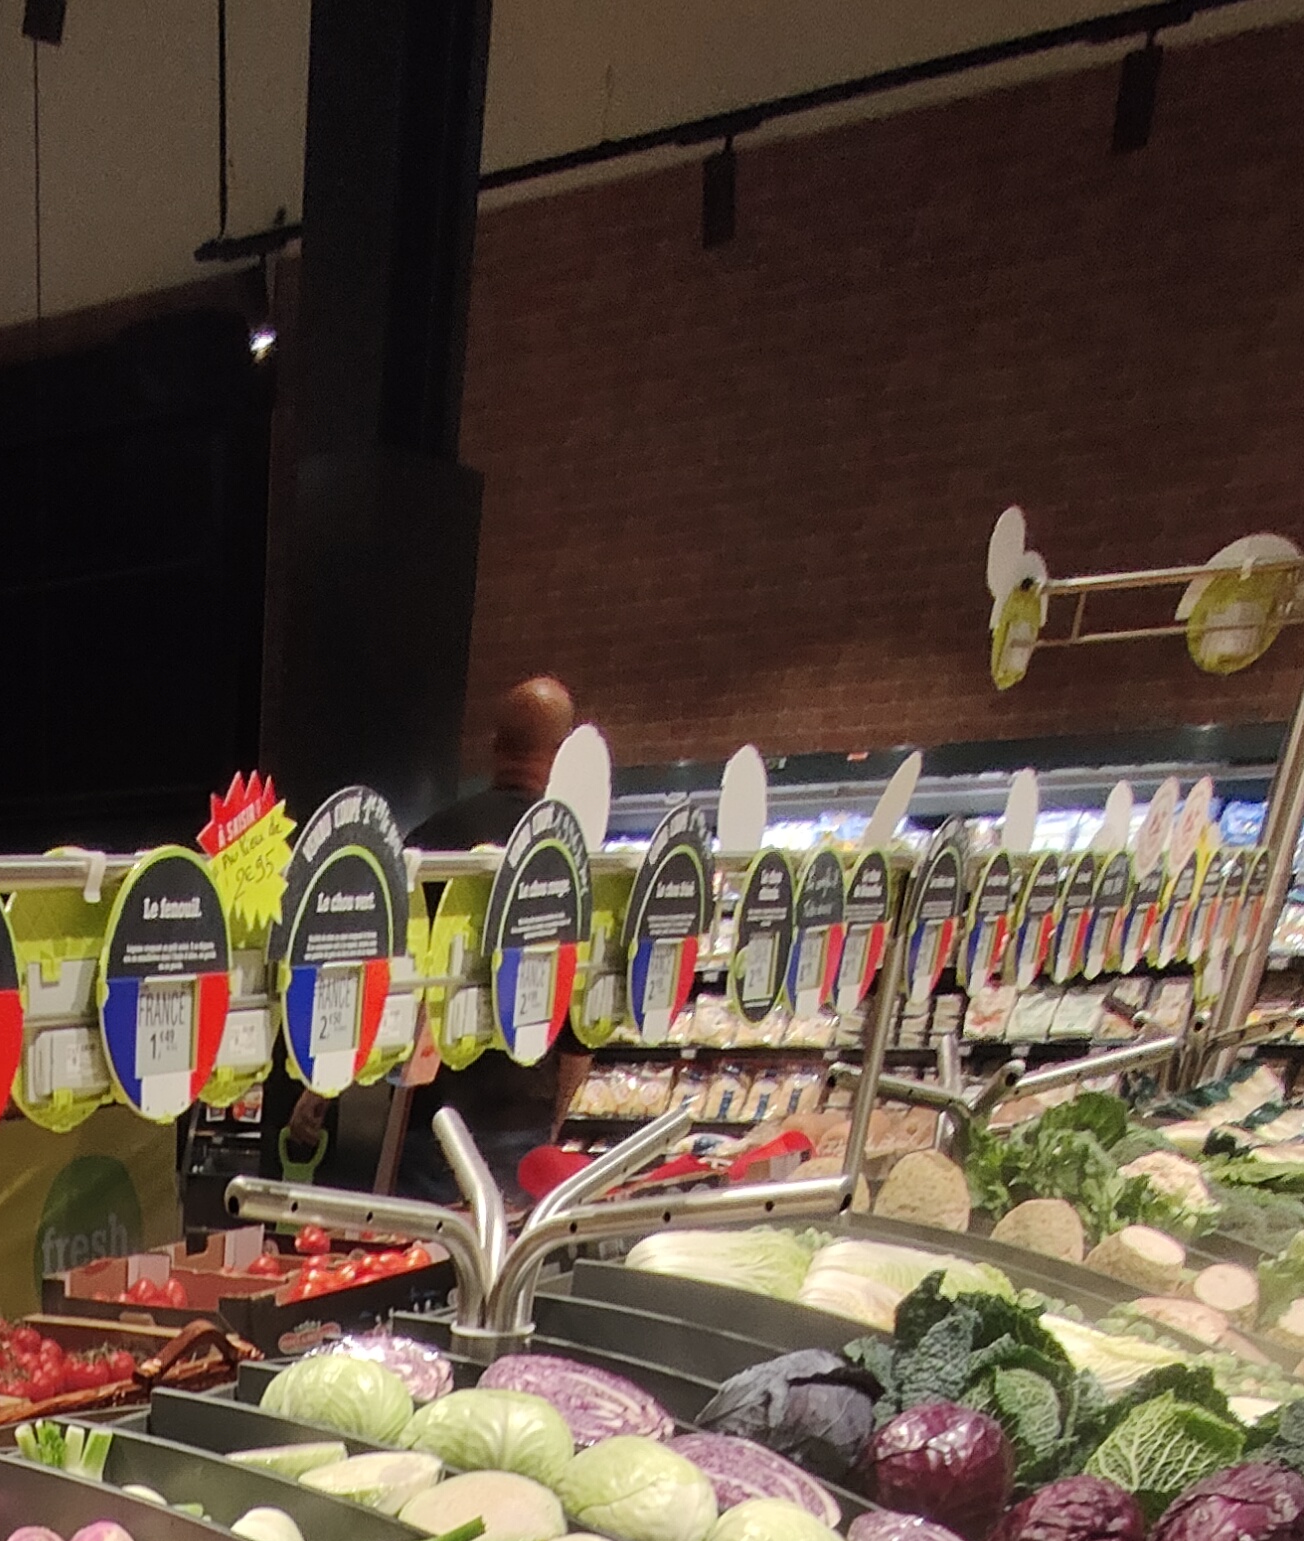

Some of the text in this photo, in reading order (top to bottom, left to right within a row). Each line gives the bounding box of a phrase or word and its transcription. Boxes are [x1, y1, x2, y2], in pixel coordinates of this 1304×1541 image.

[144, 897, 159, 920] Le
[316, 891, 330, 913] Le
[330, 891, 355, 912] chou
[139, 992, 186, 1028] FRANCE
[42, 1213, 128, 1275] fresh
